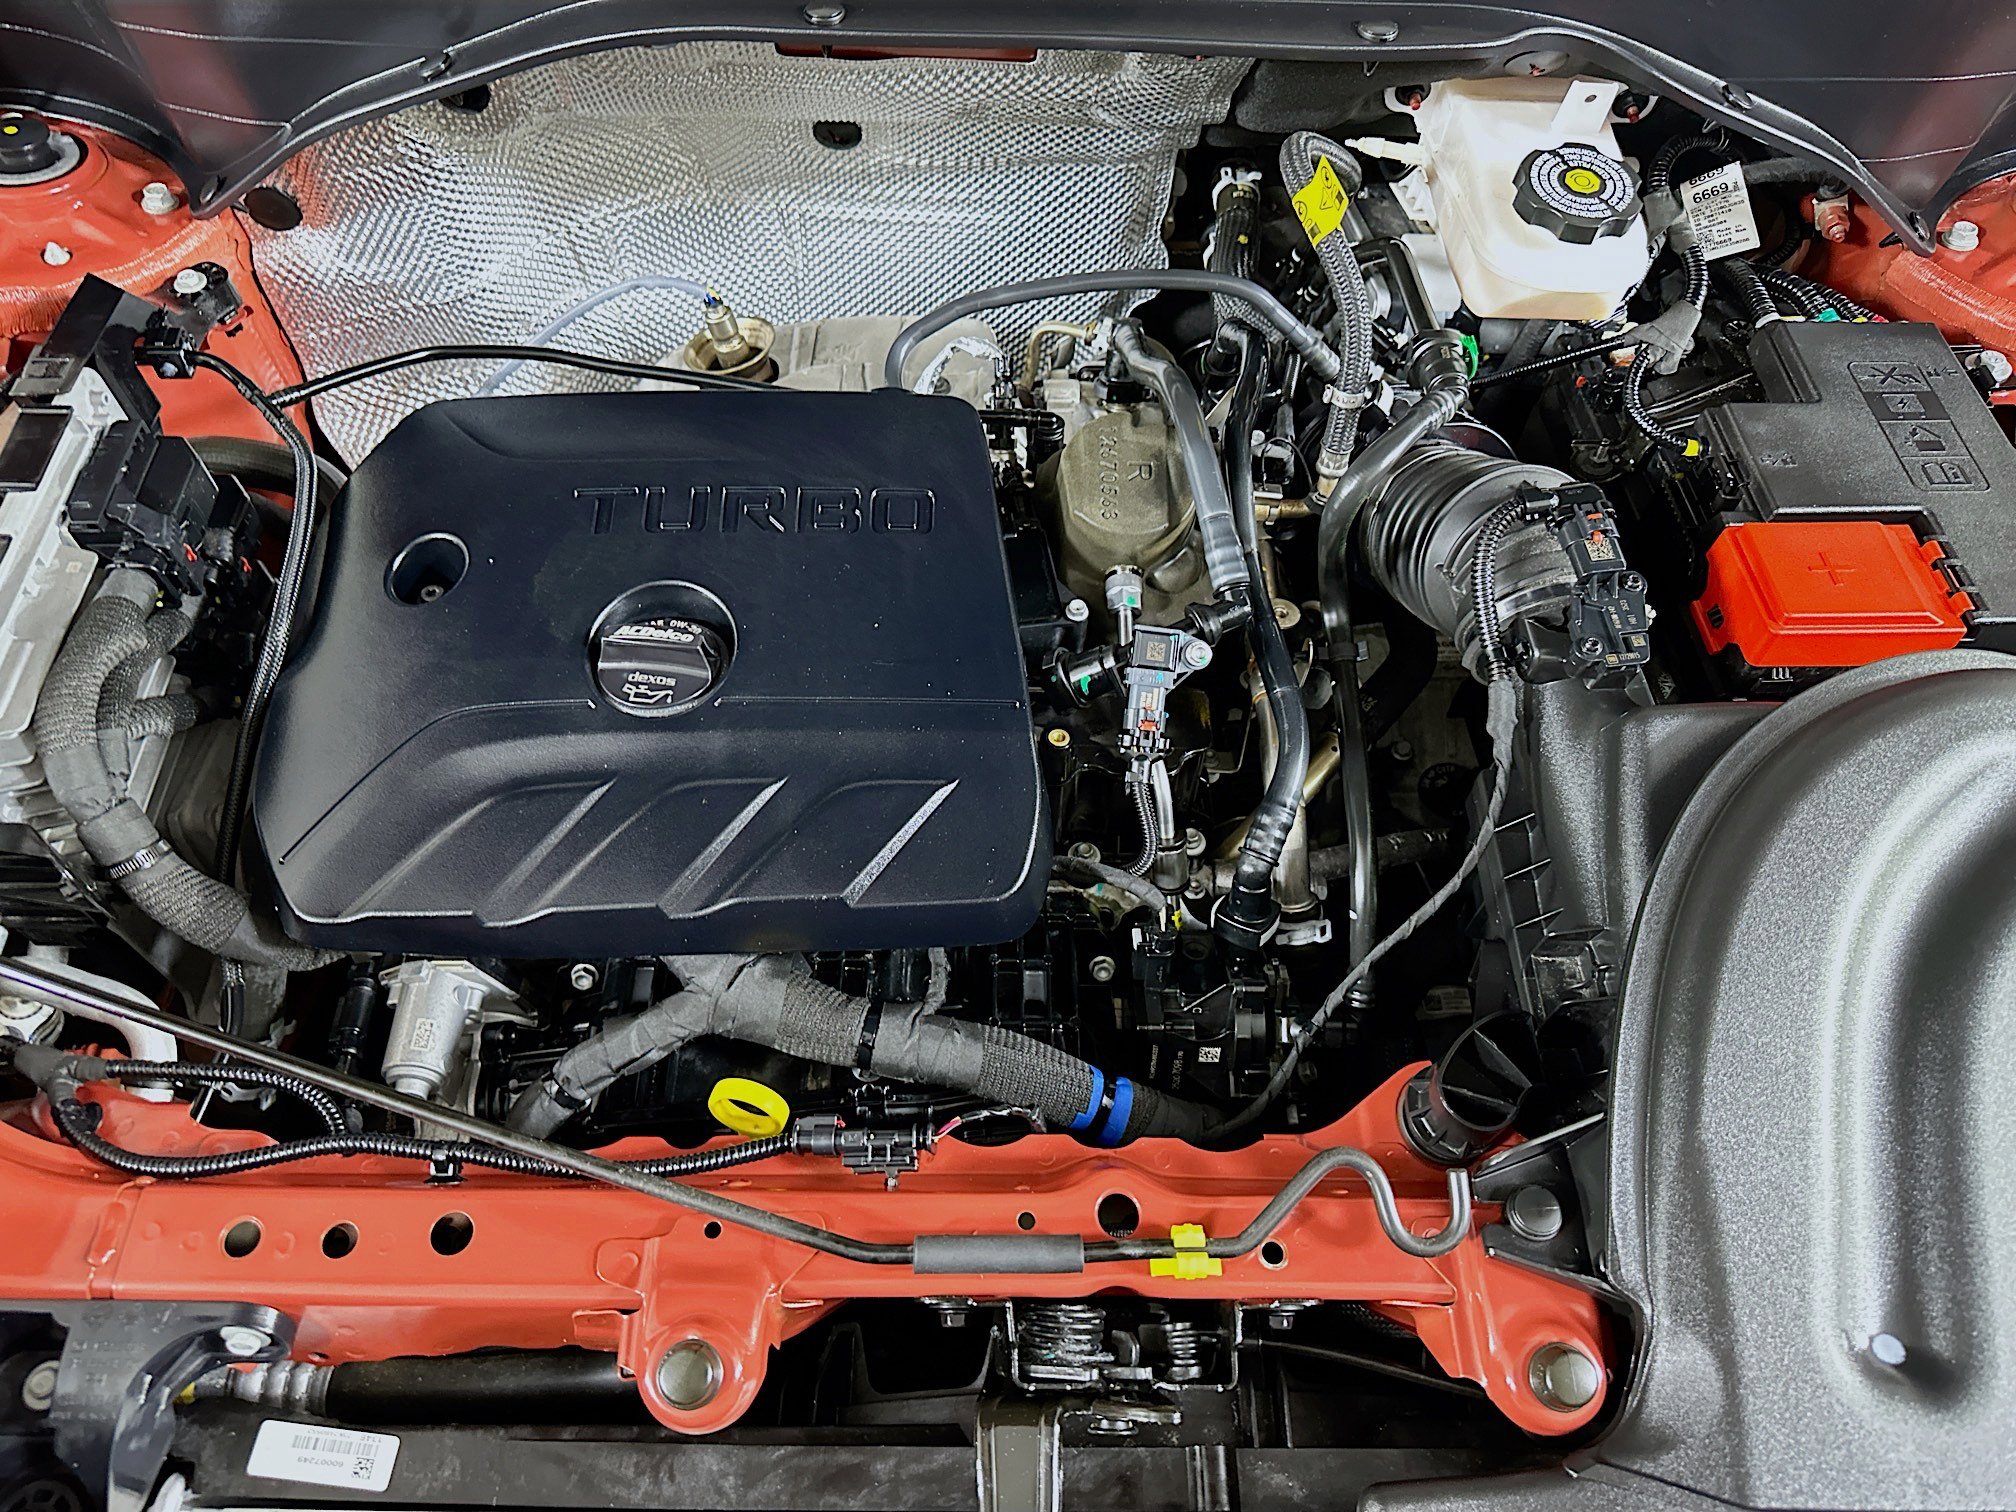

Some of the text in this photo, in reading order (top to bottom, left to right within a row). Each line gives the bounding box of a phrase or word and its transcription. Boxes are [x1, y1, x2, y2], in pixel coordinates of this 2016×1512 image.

[1693, 182, 1729, 203] 6669
[1128, 458, 1153, 481] R
[573, 485, 937, 536] TURBO
[614, 625, 694, 642] ACDelco
[627, 671, 677, 687] dexos
[297, 1456, 344, 1468] 60007249
